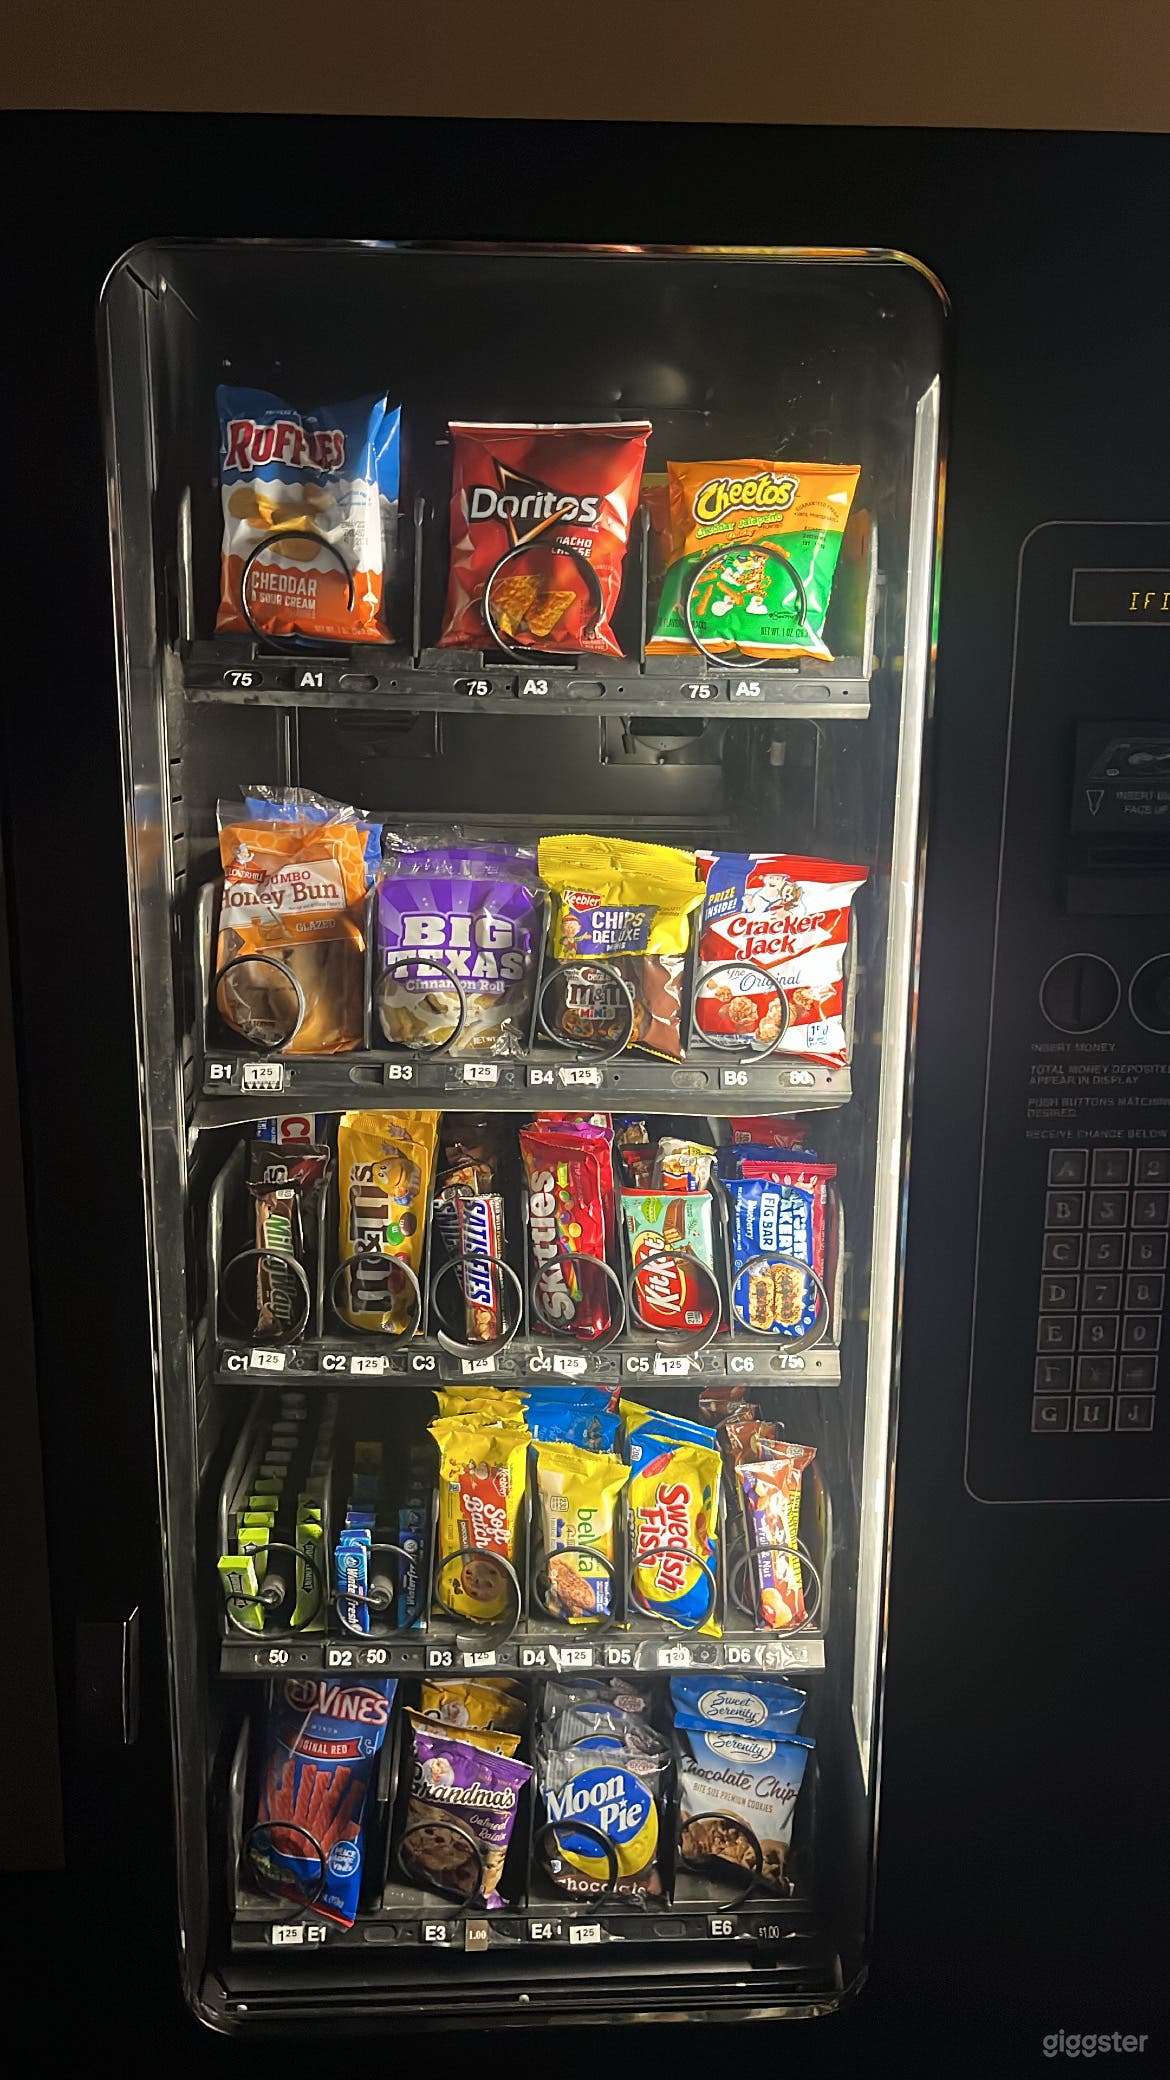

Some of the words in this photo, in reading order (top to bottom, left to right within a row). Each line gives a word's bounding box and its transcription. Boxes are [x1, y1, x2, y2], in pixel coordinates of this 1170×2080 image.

[224, 419, 345, 473] RUFFLES
[694, 472, 797, 522] Cheetos
[470, 488, 600, 524] Doritos
[251, 571, 317, 597] CHEDDAR
[260, 592, 282, 606] SOUR
[284, 595, 316, 610] CREAM
[231, 672, 253, 687] 75
[300, 672, 324, 688] A1
[523, 680, 548, 695] A3
[466, 681, 488, 696] 75
[688, 685, 711, 698] 75
[736, 682, 761, 696] A5
[267, 870, 311, 887] JUMBO
[291, 882, 339, 903] Bun
[564, 890, 600, 907] Keebler
[708, 887, 736, 906] PRIZE
[704, 898, 738, 921] INSIDE!
[591, 911, 646, 930] CHIPS
[727, 911, 826, 938] Cracker
[402, 916, 513, 949] BIG
[592, 929, 641, 944] DELUXE
[737, 936, 798, 960] Jack
[387, 949, 525, 980] TEXAS
[480, 981, 505, 992] Roll
[739, 970, 801, 992] Original
[210, 1065, 232, 1080] B1
[388, 1064, 413, 1080] B3
[530, 1069, 554, 1085] B4
[724, 1069, 748, 1085] B6
[1030, 1065, 1065, 1075] TOTAL
[1068, 1064, 1109, 1075] MONEY
[1112, 1064, 1170, 1075] DEPOSITE
[1029, 1075, 1076, 1086] APPEAR
[1092, 1075, 1140, 1086] DISPLAY
[1061, 1097, 1115, 1107] BUTTONS
[763, 1198, 775, 1217] FIG
[1055, 1201, 1072, 1219] B
[762, 1221, 774, 1246] BAR
[262, 1214, 295, 1274] Mily
[468, 1200, 492, 1305] SATISFIES
[1052, 1243, 1072, 1260] C
[1097, 1243, 1110, 1259] 5
[1048, 1284, 1067, 1302] D
[1095, 1284, 1107, 1301] 7
[1046, 1324, 1063, 1342] E
[1091, 1325, 1104, 1342] 9
[227, 1355, 248, 1370] C1
[322, 1355, 346, 1370] C2
[412, 1355, 436, 1370] C3
[529, 1355, 551, 1371] C4
[626, 1355, 650, 1372] C5
[730, 1356, 755, 1372] C6
[1041, 1405, 1058, 1422] G
[1127, 1403, 1140, 1421] J
[463, 1493, 492, 1549] Batch
[483, 1503, 511, 1545] Soft
[577, 1508, 602, 1572] belVta
[639, 1507, 667, 1568] Fish
[656, 1484, 692, 1593] Swedish
[758, 1525, 769, 1546] Frui
[762, 1561, 772, 1578] Nut
[346, 1567, 359, 1624] Wintefresh
[268, 1650, 289, 1664] 50
[329, 1650, 352, 1666] D2
[366, 1650, 387, 1663] 50
[429, 1651, 453, 1666] D3
[523, 1650, 546, 1666] D4
[608, 1649, 631, 1665] D5
[728, 1649, 750, 1664] D6
[319, 1681, 390, 1726] VINES
[712, 1691, 754, 1706] Sweet
[707, 1704, 758, 1724] Serenity
[331, 1744, 348, 1755] RED
[713, 1733, 767, 1759] Serenity
[409, 1762, 516, 1809] Grandma's
[755, 1775, 798, 1806] Chip
[546, 1775, 626, 1824] Moon
[693, 1782, 706, 1794] BITE
[707, 1787, 719, 1798] SIZE
[747, 1799, 774, 1814] COOKIES
[598, 1803, 643, 1835] Pie
[308, 1926, 327, 1942] E1
[425, 1926, 446, 1942] E3
[469, 1930, 487, 1940] 1.00
[531, 1923, 553, 1939] E4
[712, 1919, 733, 1935] E6
[758, 1925, 780, 1939] $1.00
